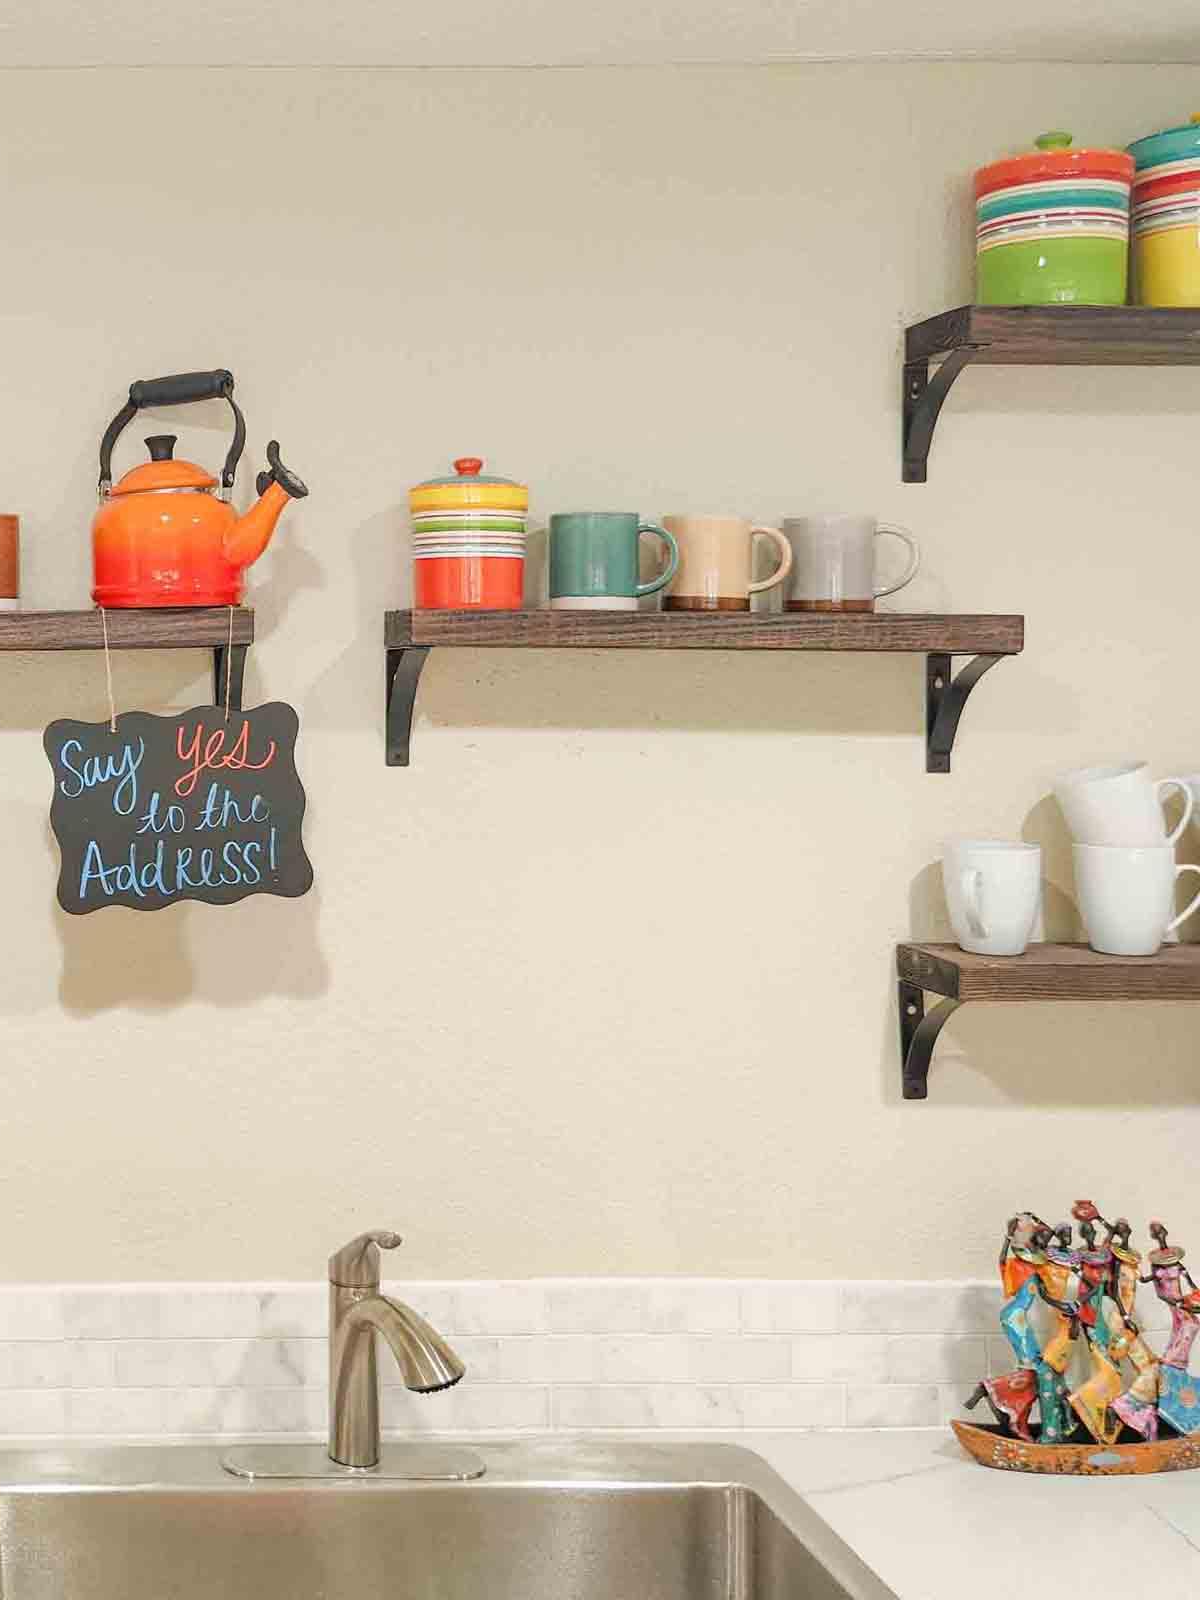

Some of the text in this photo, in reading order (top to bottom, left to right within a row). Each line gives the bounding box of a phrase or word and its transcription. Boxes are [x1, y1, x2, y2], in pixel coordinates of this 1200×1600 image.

[59, 735, 145, 815] Say
[136, 782, 270, 834] to the
